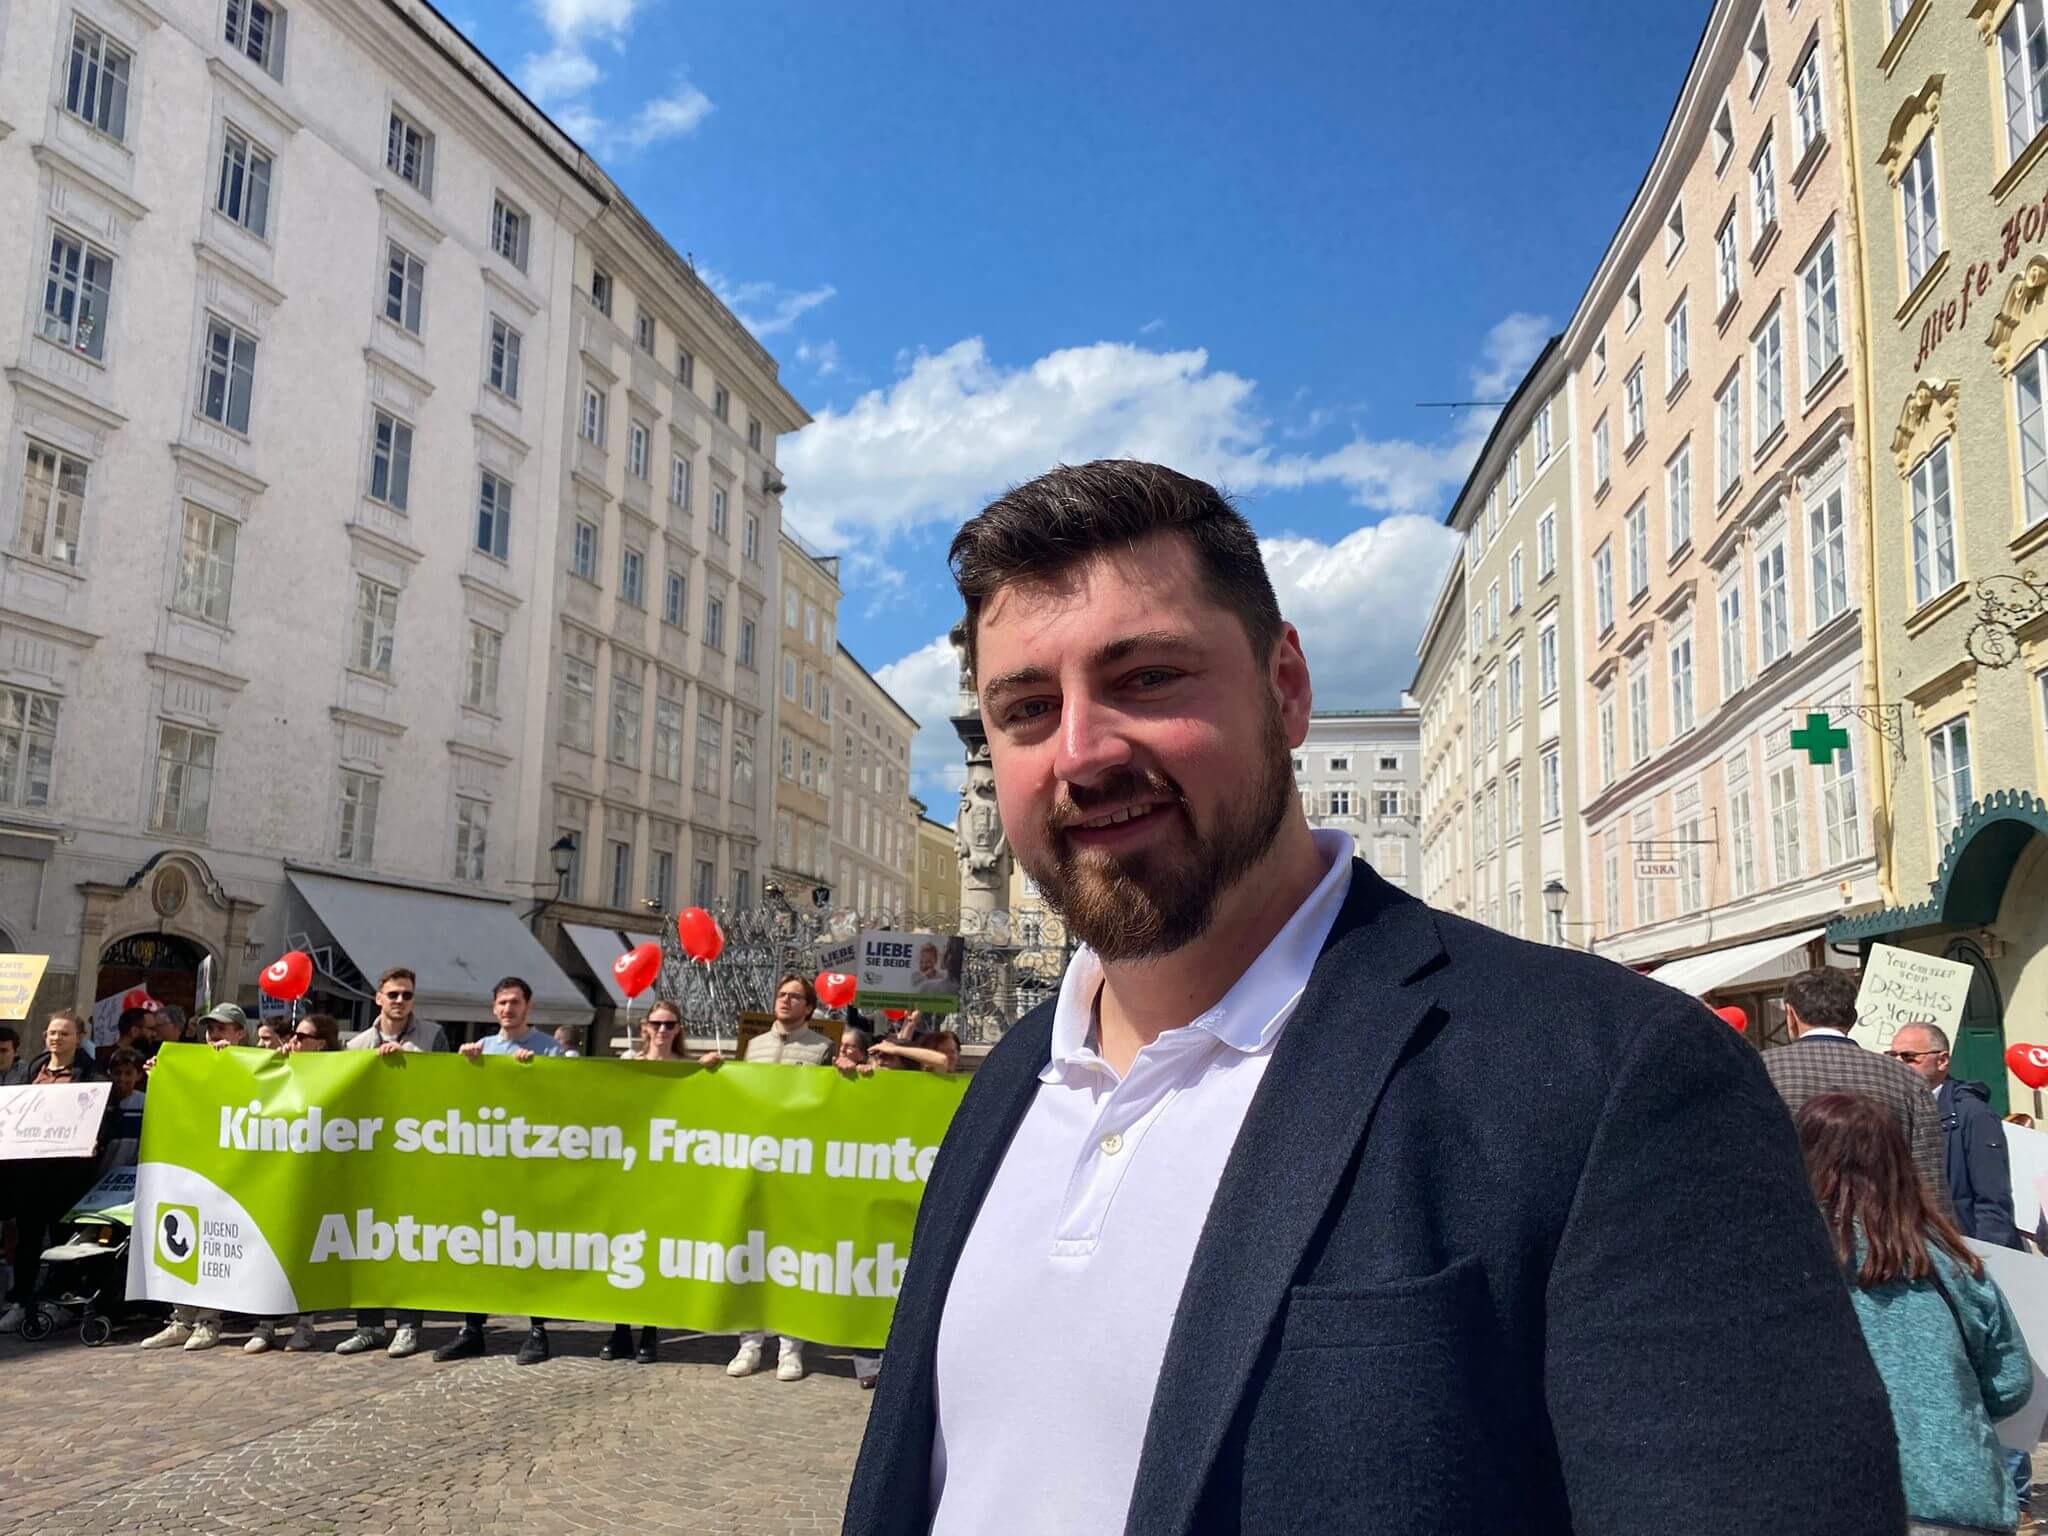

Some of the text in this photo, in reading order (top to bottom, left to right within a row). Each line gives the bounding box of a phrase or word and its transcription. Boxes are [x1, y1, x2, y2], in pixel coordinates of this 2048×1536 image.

[1914, 299, 1957, 374] Alte
[820, 944, 856, 965] LIEBE
[865, 941, 913, 959] LIEBE
[864, 957, 912, 969] SIE BEIDE
[1869, 973, 1952, 1013] DREAMS
[218, 1099, 384, 1154] Kinder
[392, 1106, 637, 1171] schützen,
[648, 1117, 813, 1175] Frauen
[203, 1220, 239, 1239] JUGEND
[202, 1237, 244, 1260] FÜR DAS
[308, 1207, 647, 1290] Abtreibung
[202, 1260, 232, 1279] LEBEN
